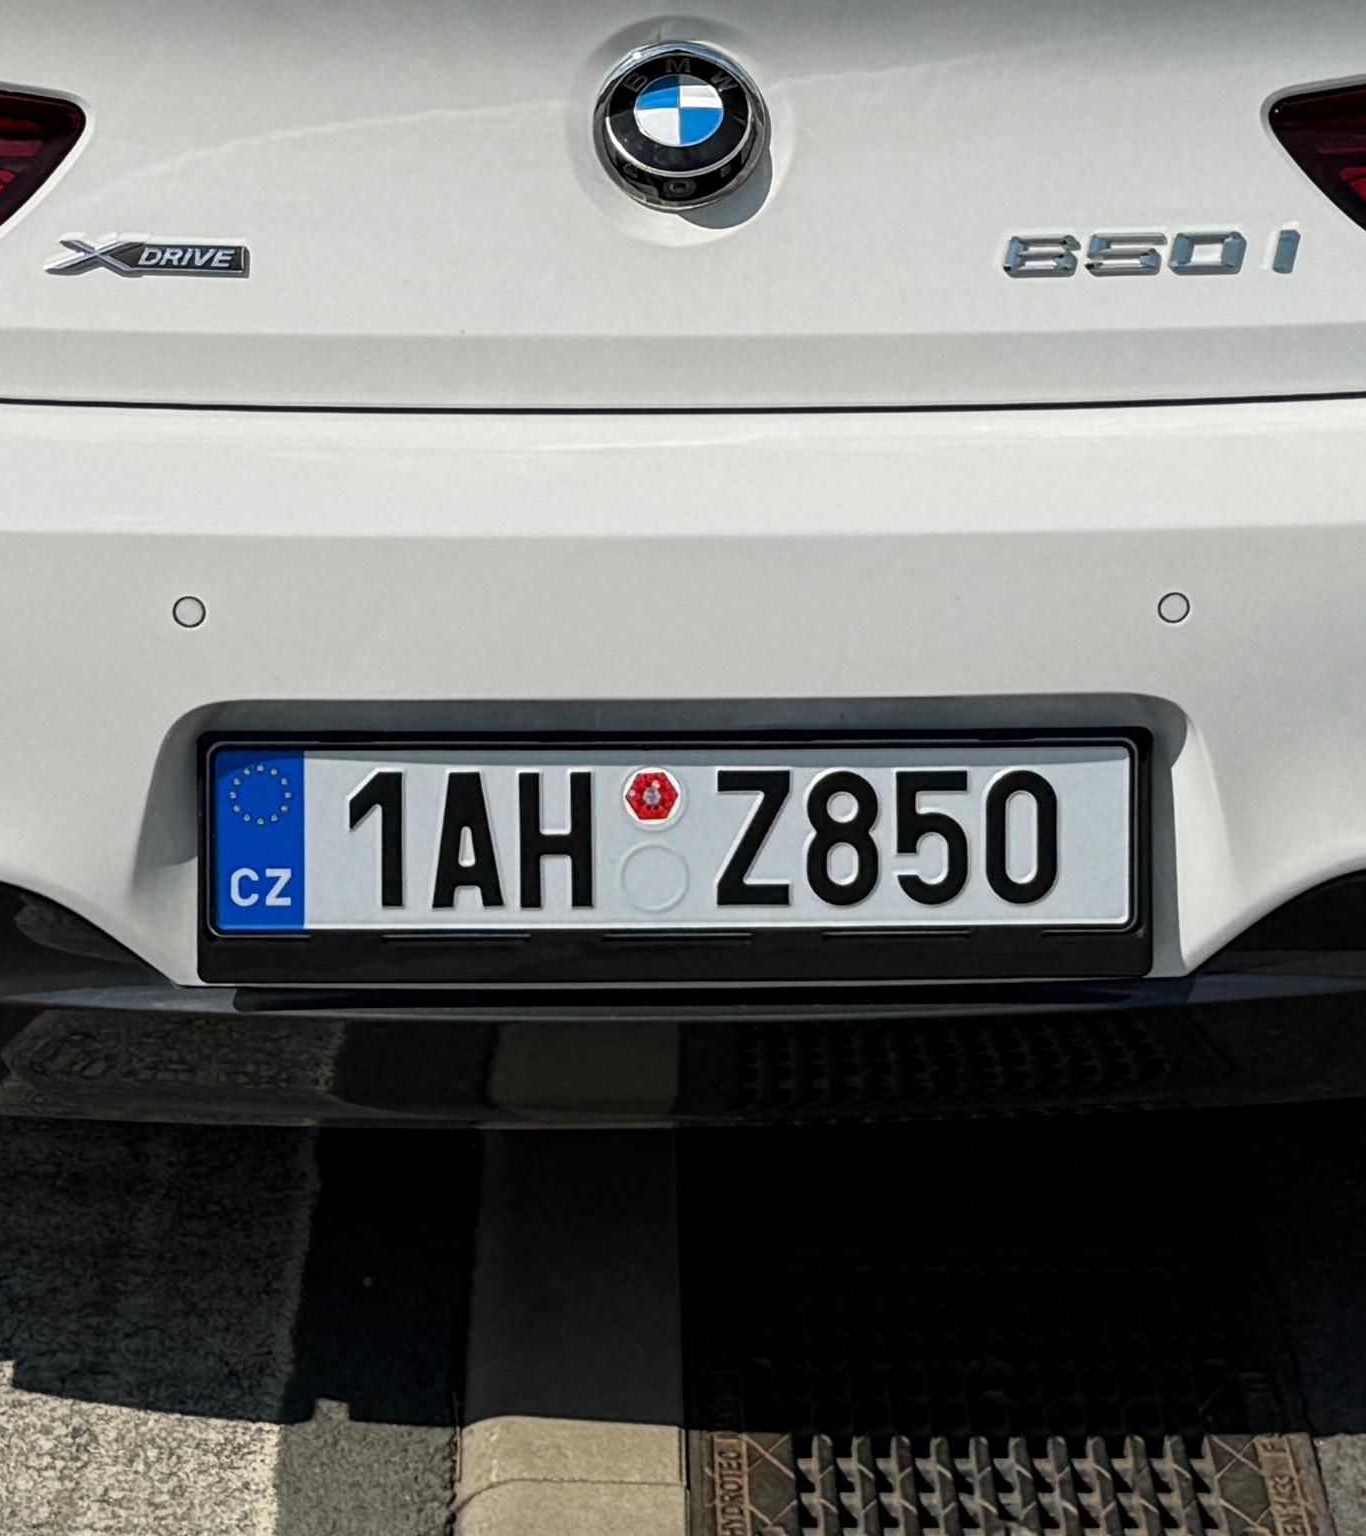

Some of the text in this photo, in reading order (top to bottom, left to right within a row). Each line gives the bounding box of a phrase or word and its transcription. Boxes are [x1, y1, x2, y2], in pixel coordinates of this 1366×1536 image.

[623, 57, 738, 93] BMW
[346, 768, 1060, 910] 1AH Z850
[230, 867, 292, 907] CZ
[718, 1450, 745, 1536] HYDROTEC
